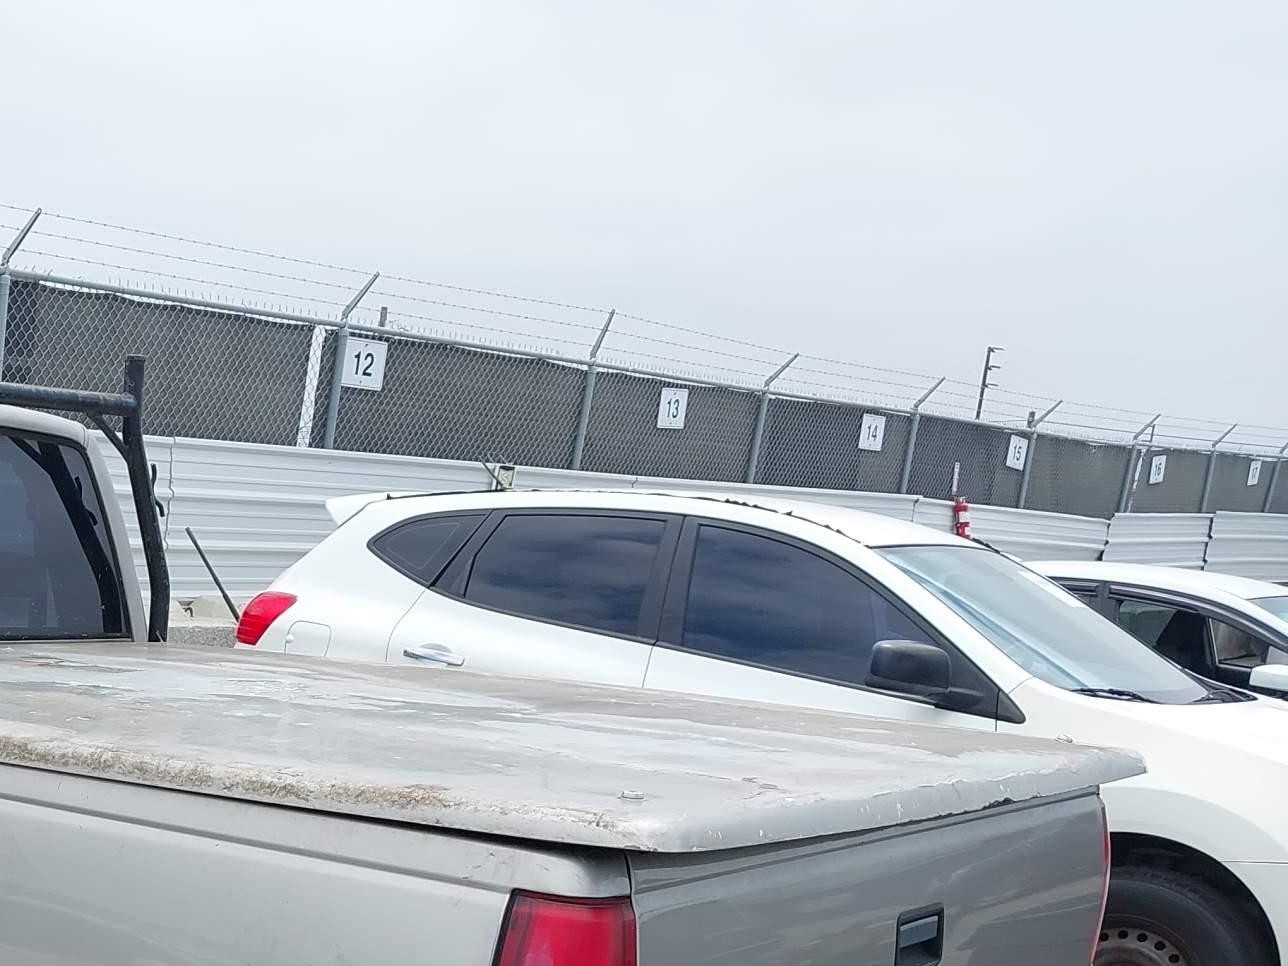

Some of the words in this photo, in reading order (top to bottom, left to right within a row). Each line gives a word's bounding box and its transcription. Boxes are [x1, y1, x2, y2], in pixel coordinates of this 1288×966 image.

[354, 350, 375, 378] 12
[667, 398, 680, 419] 13
[867, 423, 879, 442] 14
[1013, 444, 1023, 462] 15
